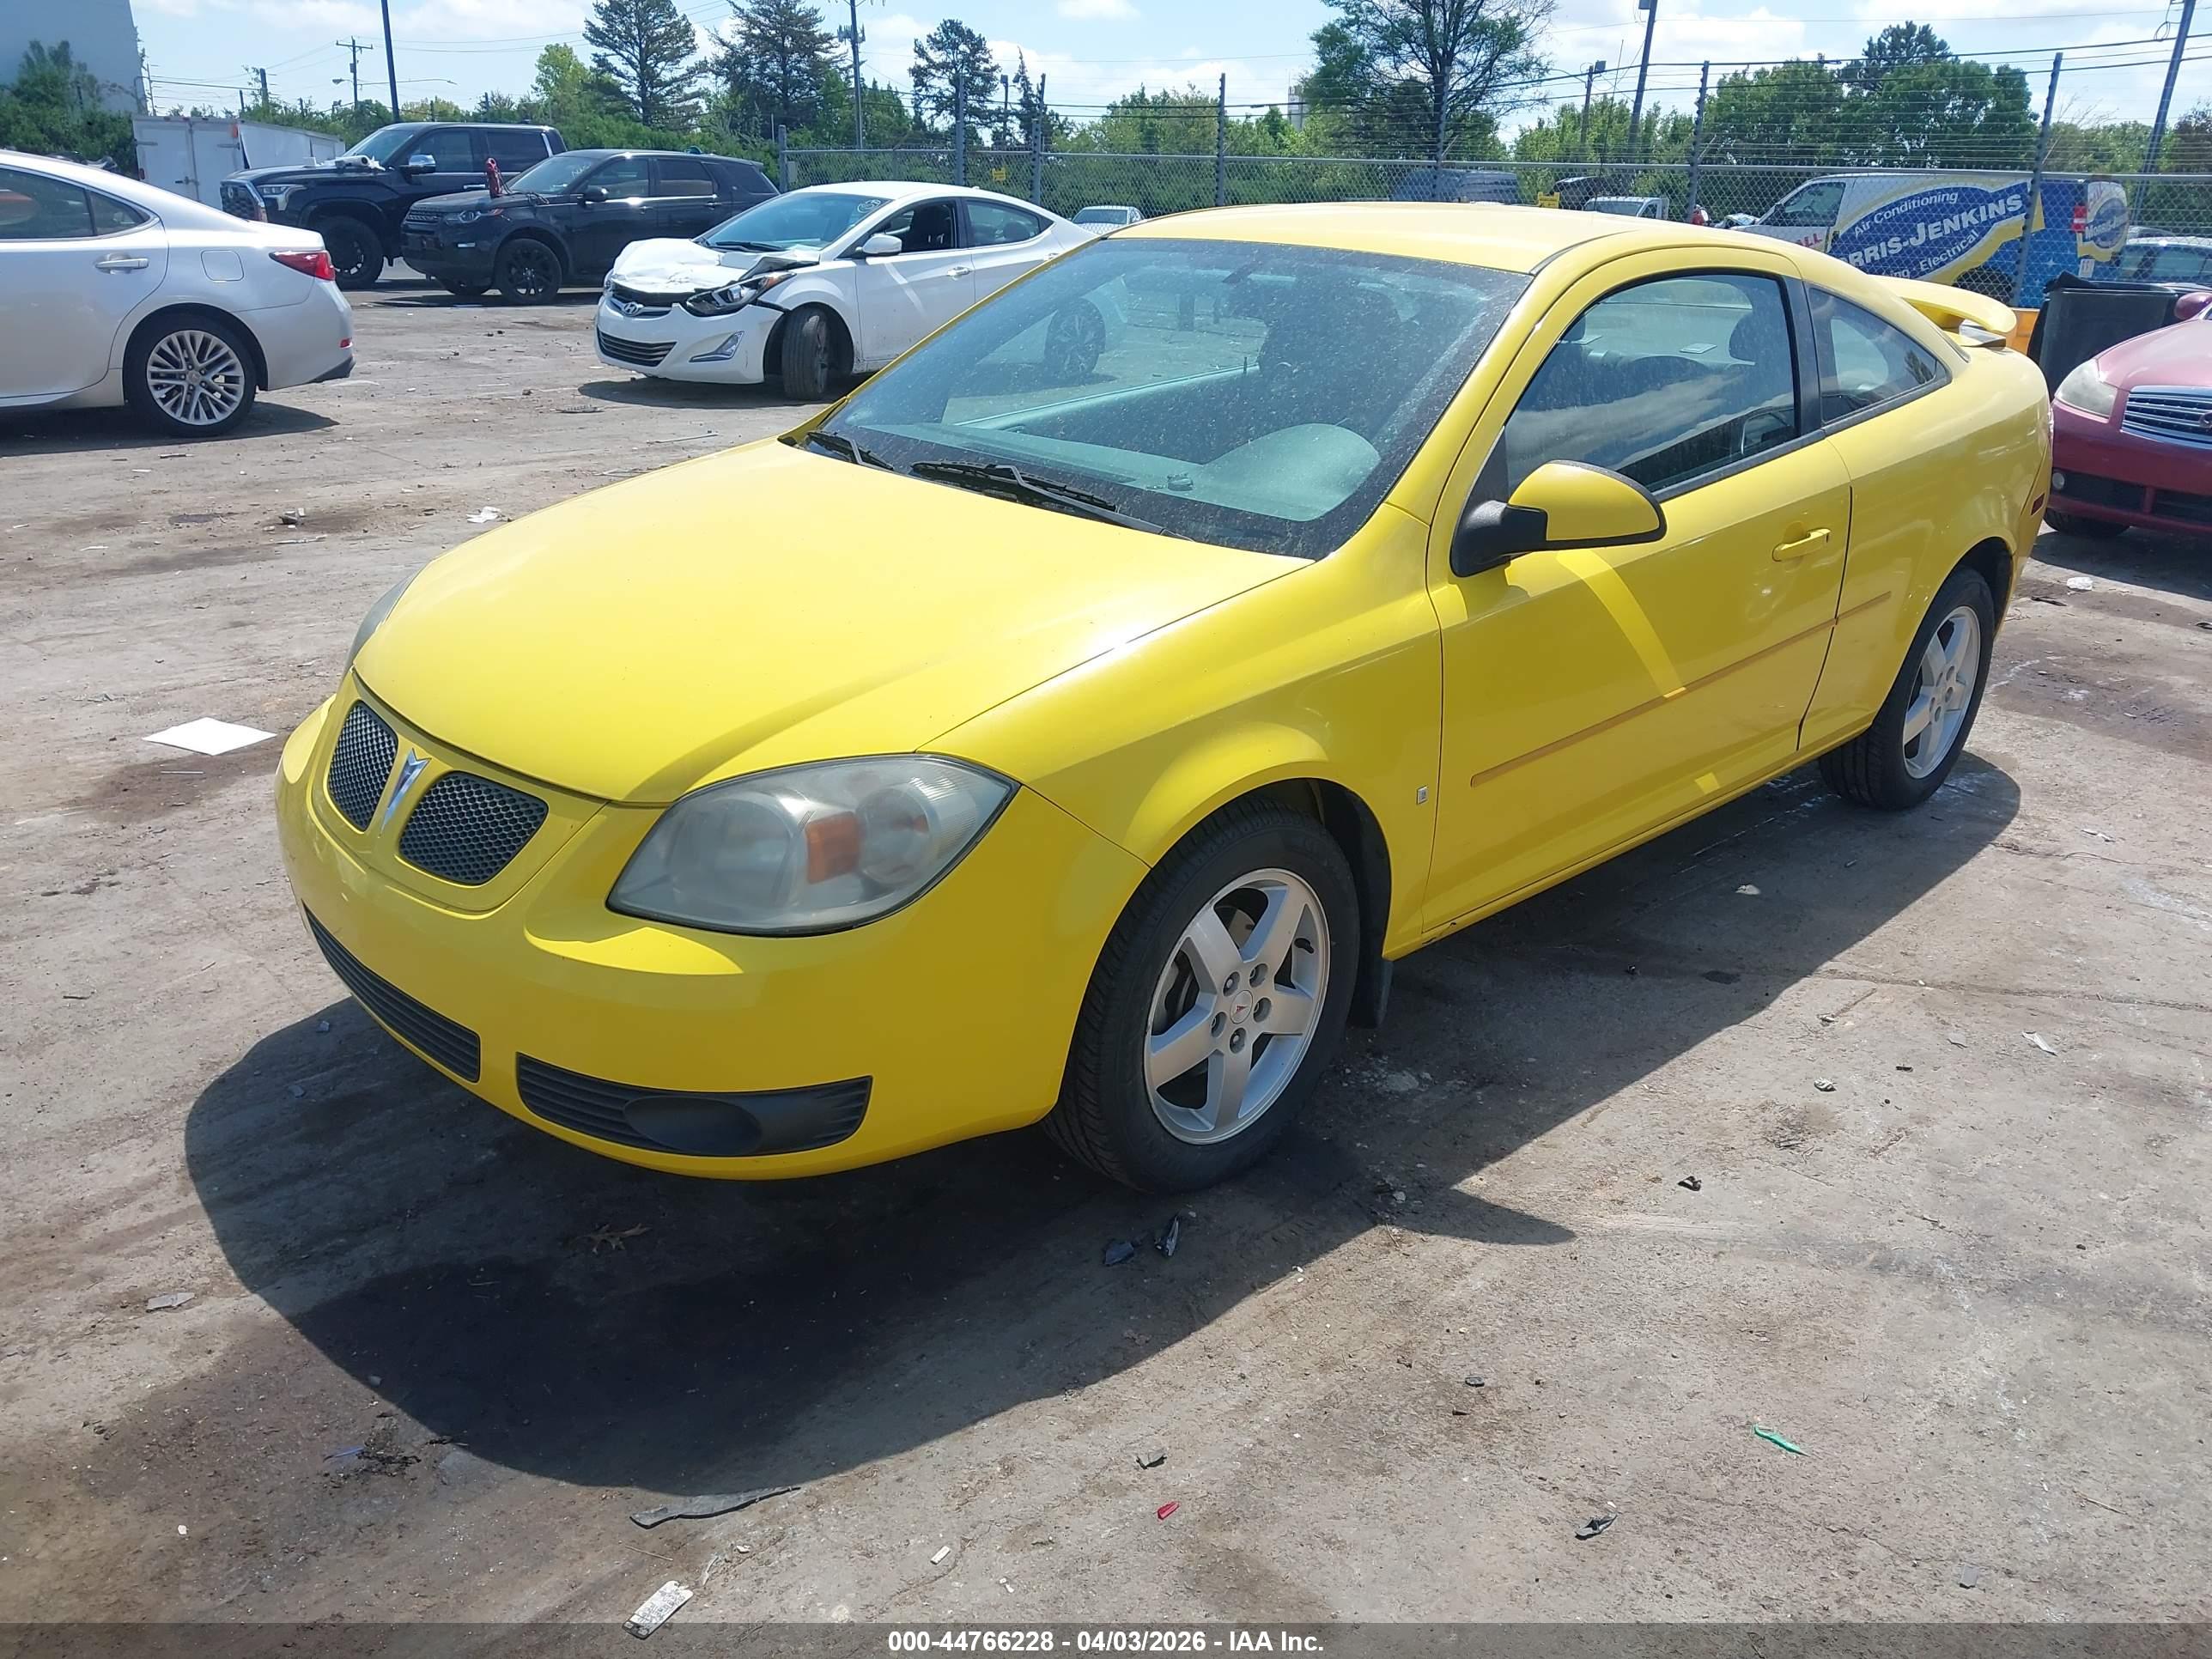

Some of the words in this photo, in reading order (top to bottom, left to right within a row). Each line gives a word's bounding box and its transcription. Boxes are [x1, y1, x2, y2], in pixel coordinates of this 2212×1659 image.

[1838, 194, 2023, 267] RRIS-JENKINS
[1854, 220, 1871, 239] Air
[1874, 191, 1959, 224] Conditioning
[1919, 229, 1979, 271] Electrical
